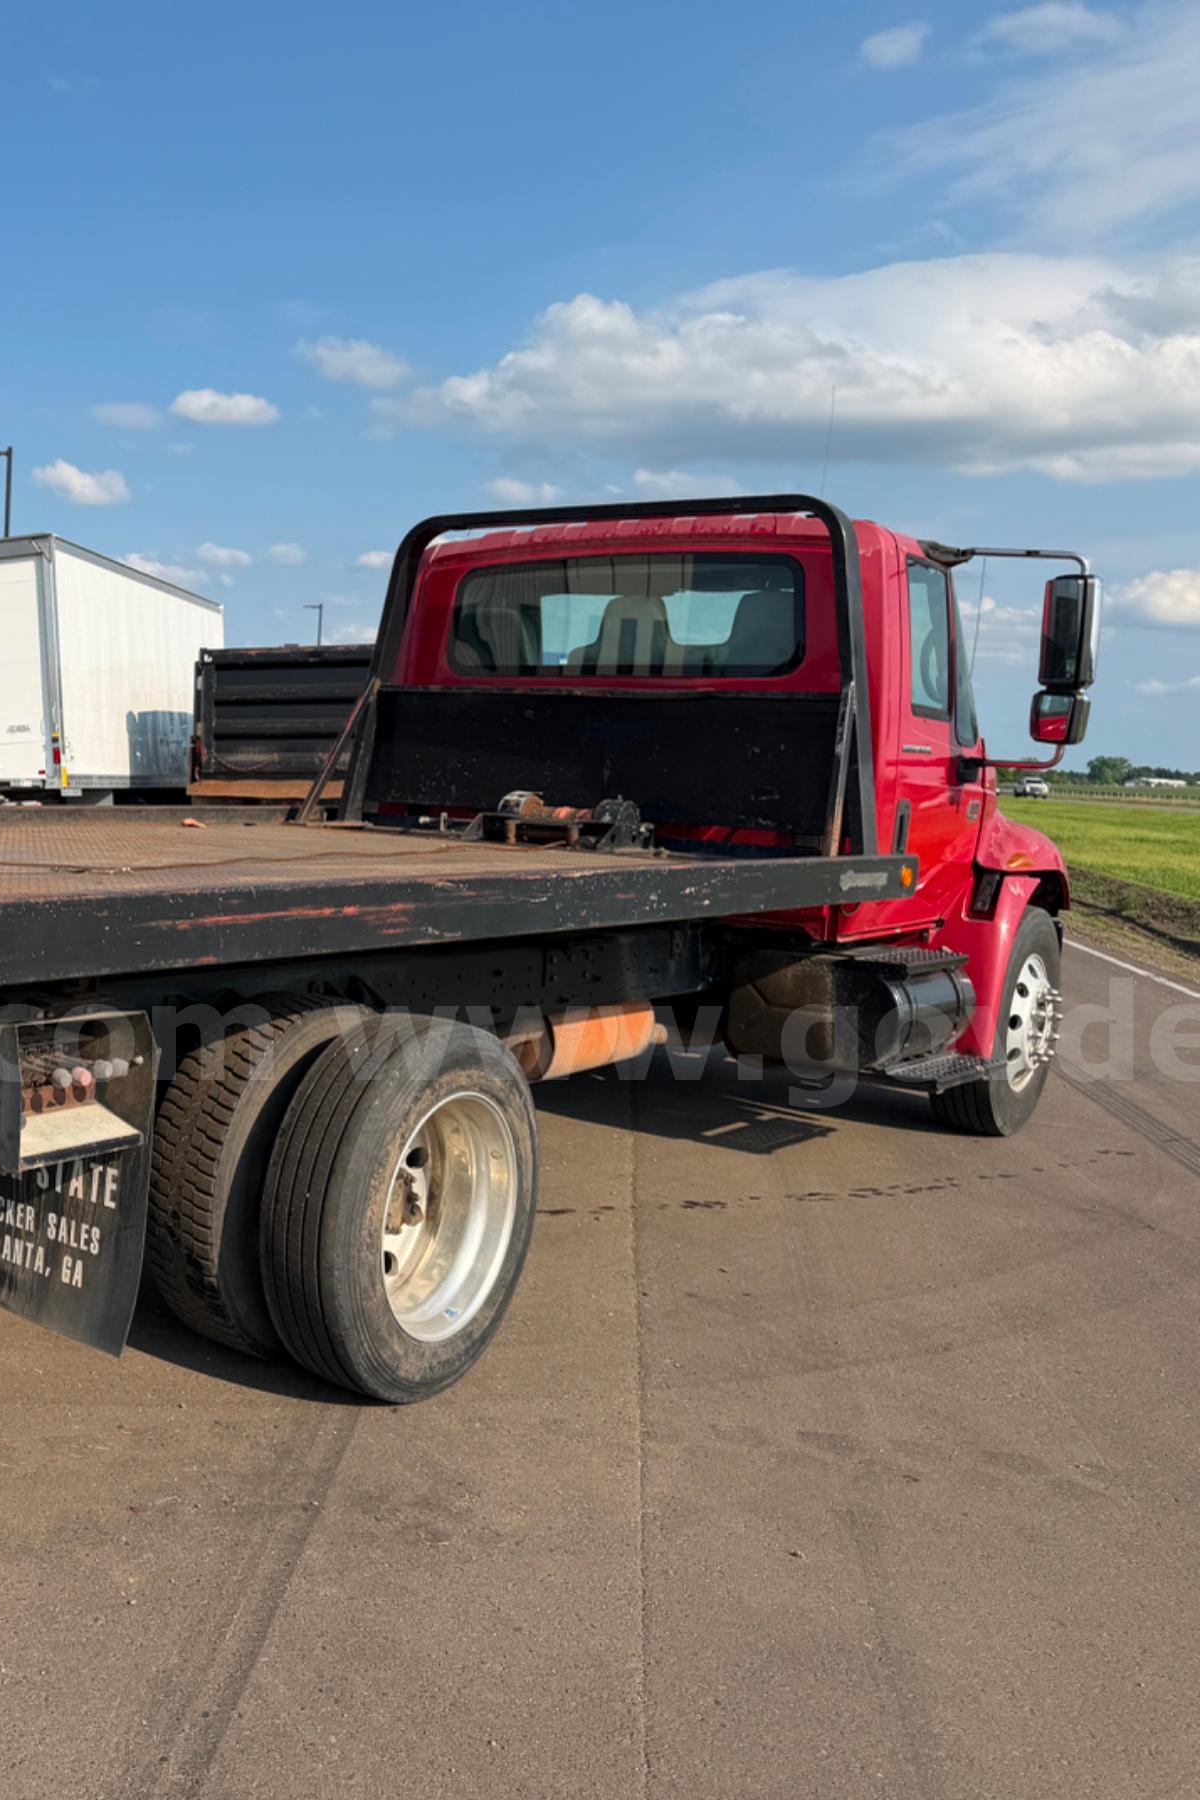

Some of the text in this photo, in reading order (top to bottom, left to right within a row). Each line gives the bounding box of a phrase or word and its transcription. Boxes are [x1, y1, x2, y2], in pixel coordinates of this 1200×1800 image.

[36, 1158, 119, 1209] STATE
[47, 1212, 100, 1255] SALES
[61, 1254, 83, 1289] GA
